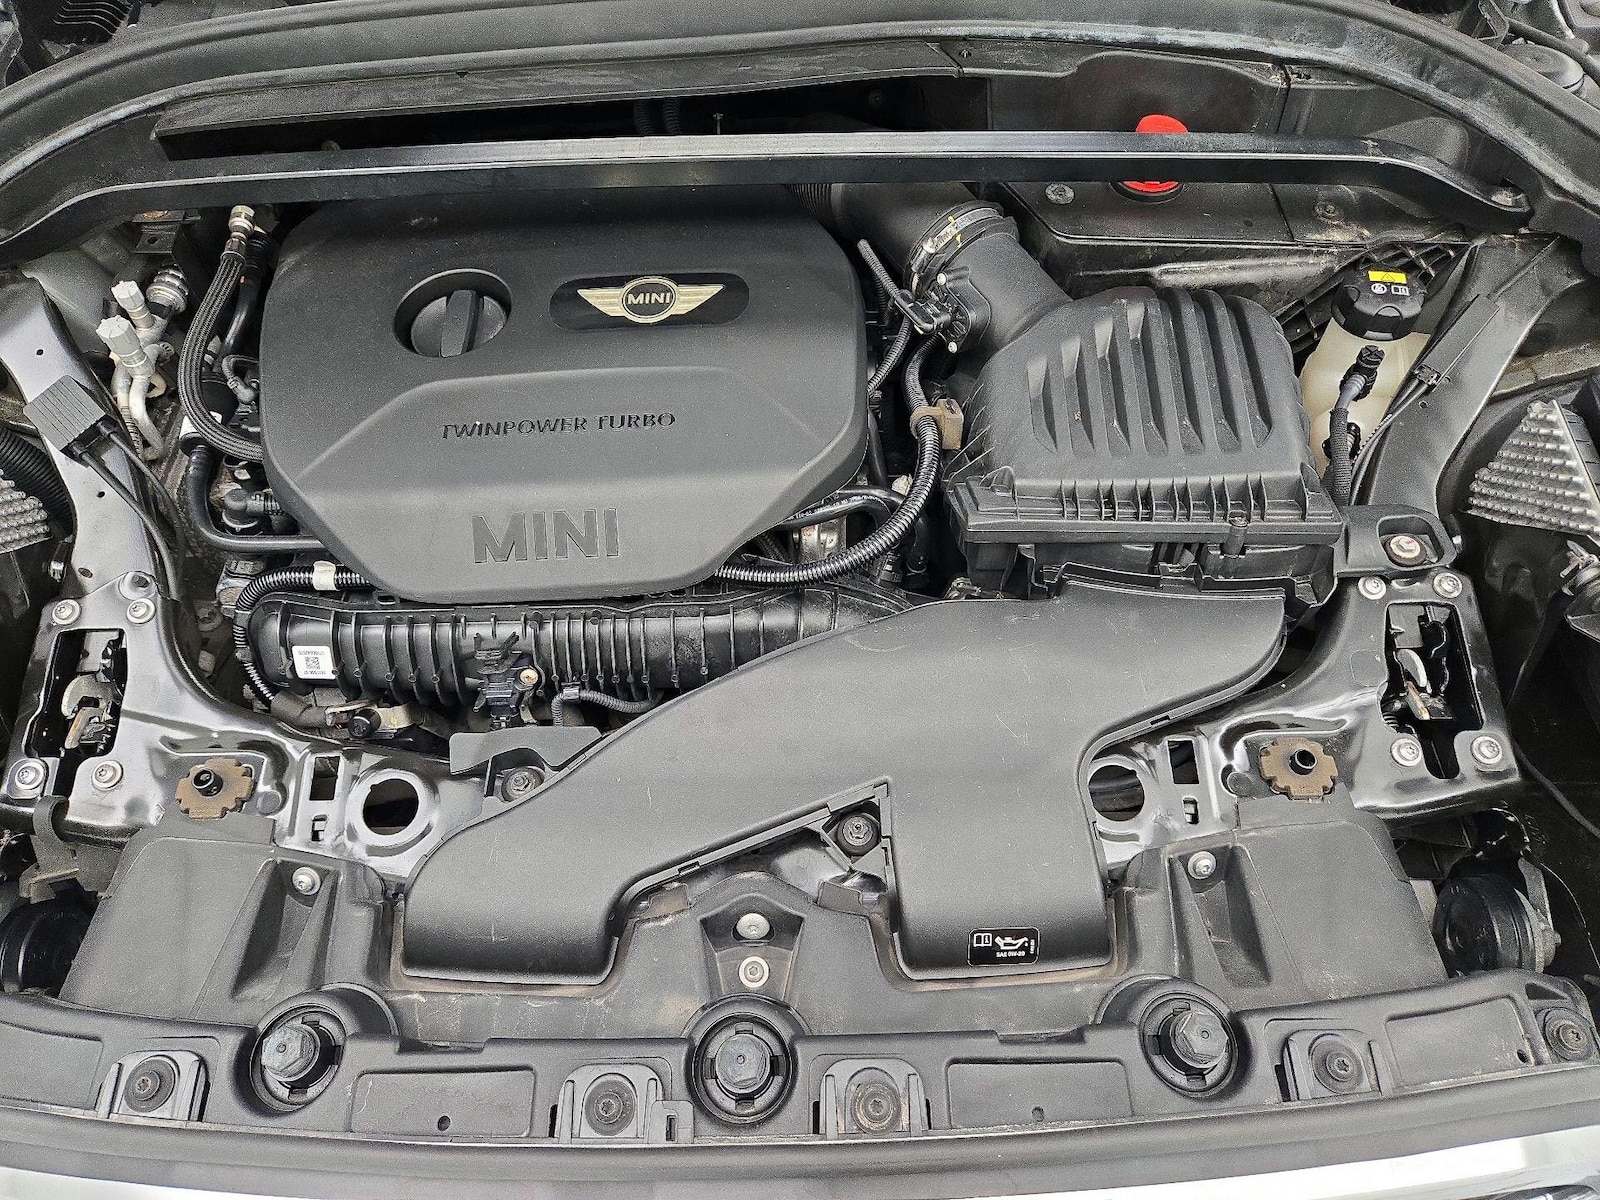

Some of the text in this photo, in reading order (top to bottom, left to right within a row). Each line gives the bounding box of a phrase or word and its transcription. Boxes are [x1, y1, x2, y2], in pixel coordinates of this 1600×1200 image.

[628, 292, 671, 306] MINI
[442, 412, 677, 440] TWINPOWER TURBO
[471, 507, 620, 565] MINI
